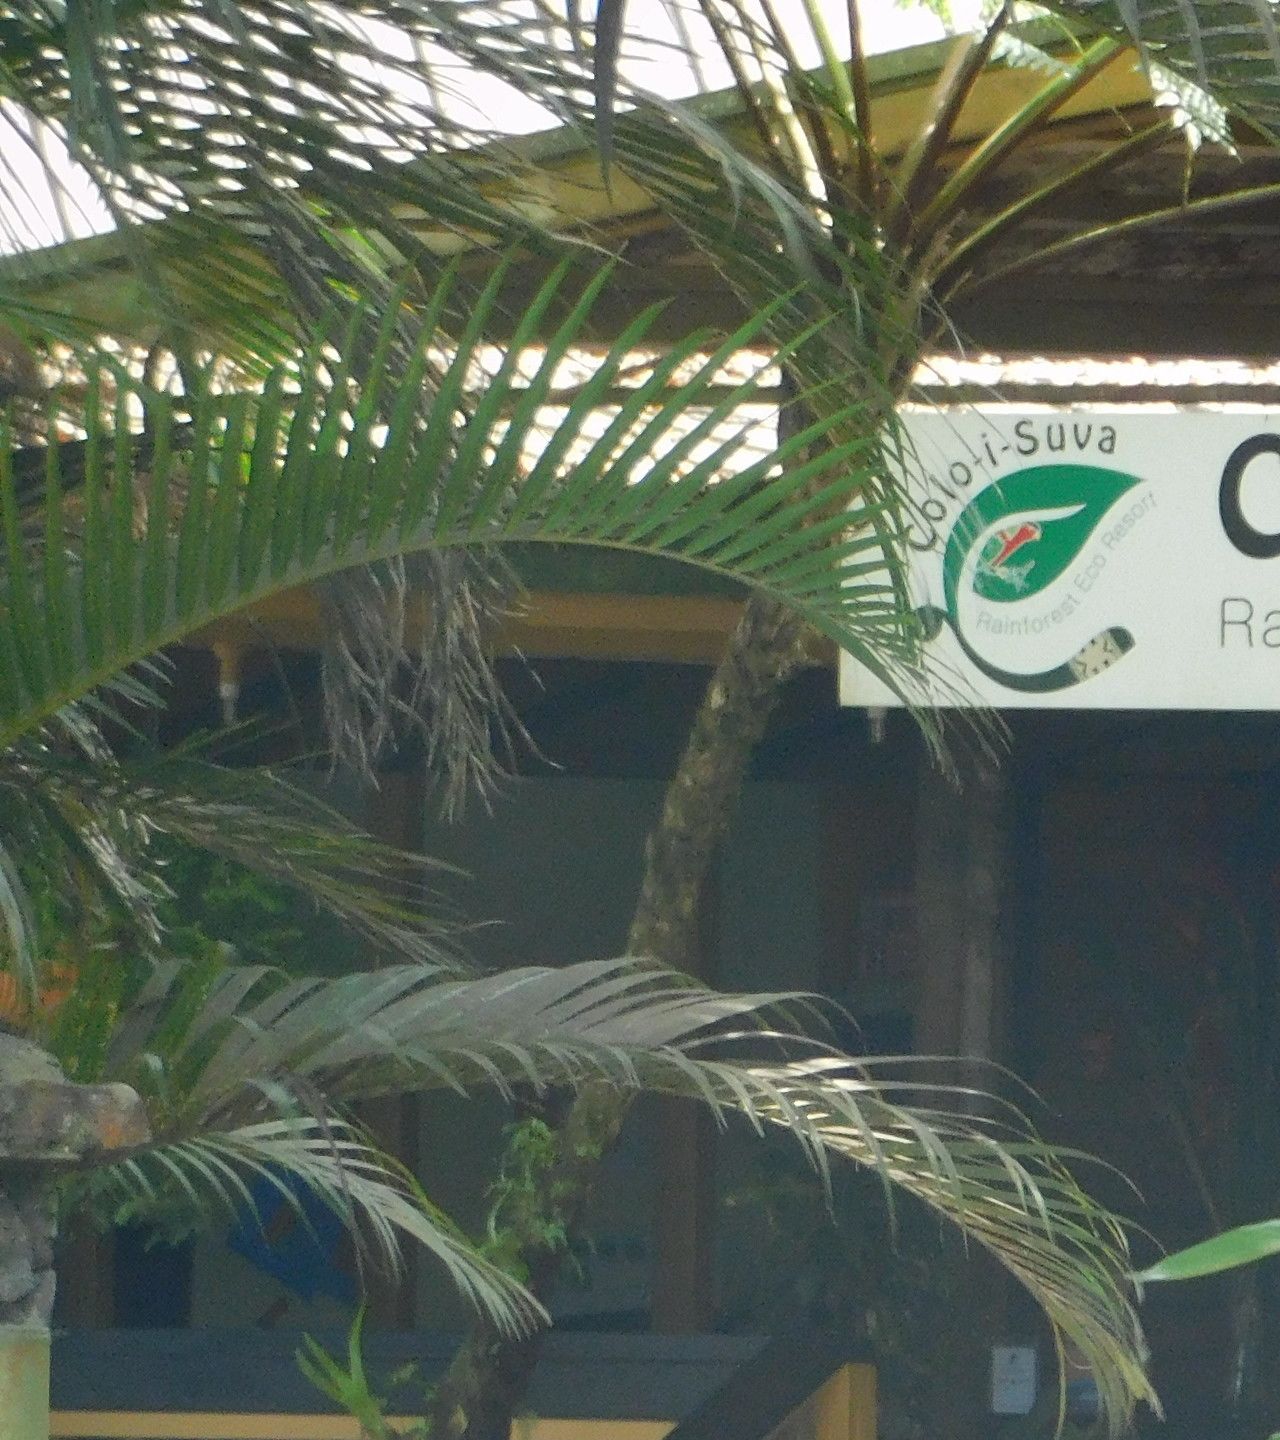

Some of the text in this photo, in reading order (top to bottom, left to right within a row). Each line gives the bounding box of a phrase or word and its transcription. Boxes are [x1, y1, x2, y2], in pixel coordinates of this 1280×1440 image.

[975, 491, 1159, 636] Rainforest Eco Resort
